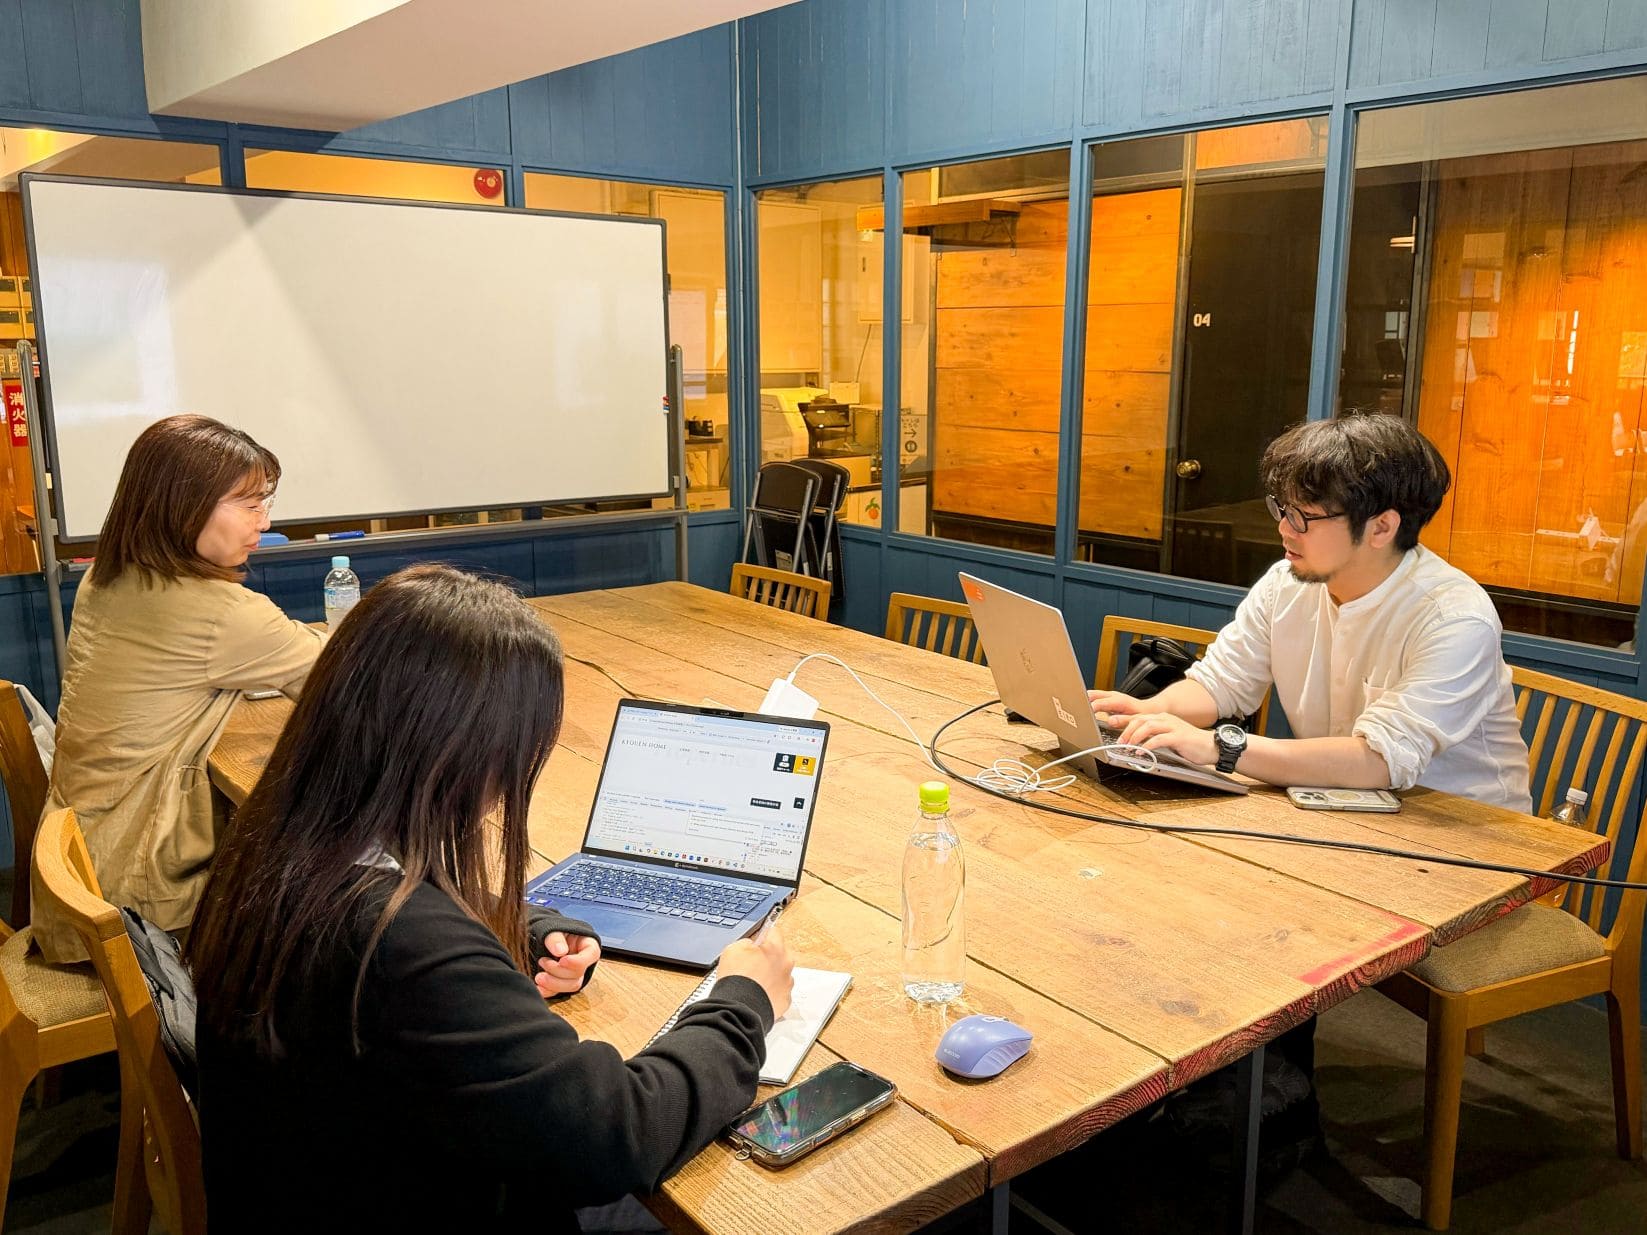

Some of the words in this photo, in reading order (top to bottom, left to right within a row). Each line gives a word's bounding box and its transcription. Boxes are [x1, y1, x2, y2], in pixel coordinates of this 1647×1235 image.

[1193, 313, 1211, 327] 04
[9, 392, 27, 437] 消火器
